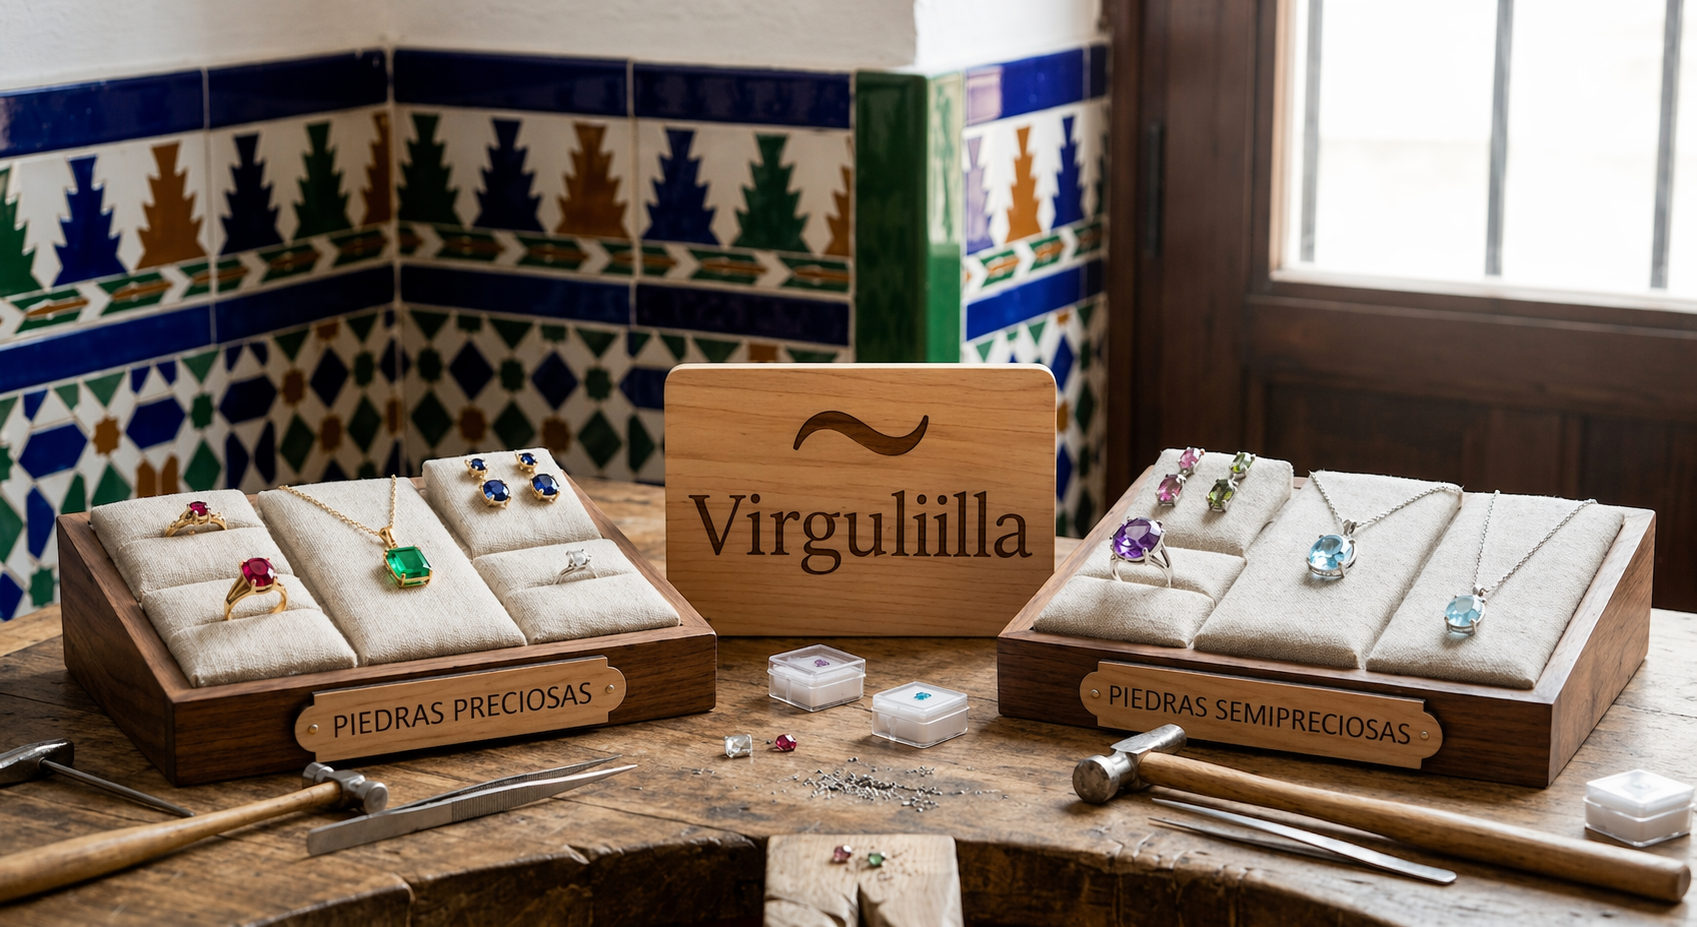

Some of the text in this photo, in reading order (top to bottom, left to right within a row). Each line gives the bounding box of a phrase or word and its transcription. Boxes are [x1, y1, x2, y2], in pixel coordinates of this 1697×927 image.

[688, 489, 1033, 576] Virguliilla
[333, 682, 593, 739] PIEDRAS PRECIOSAS
[1109, 685, 1411, 745] PIEDRAS SEMIPRECIOSAS
